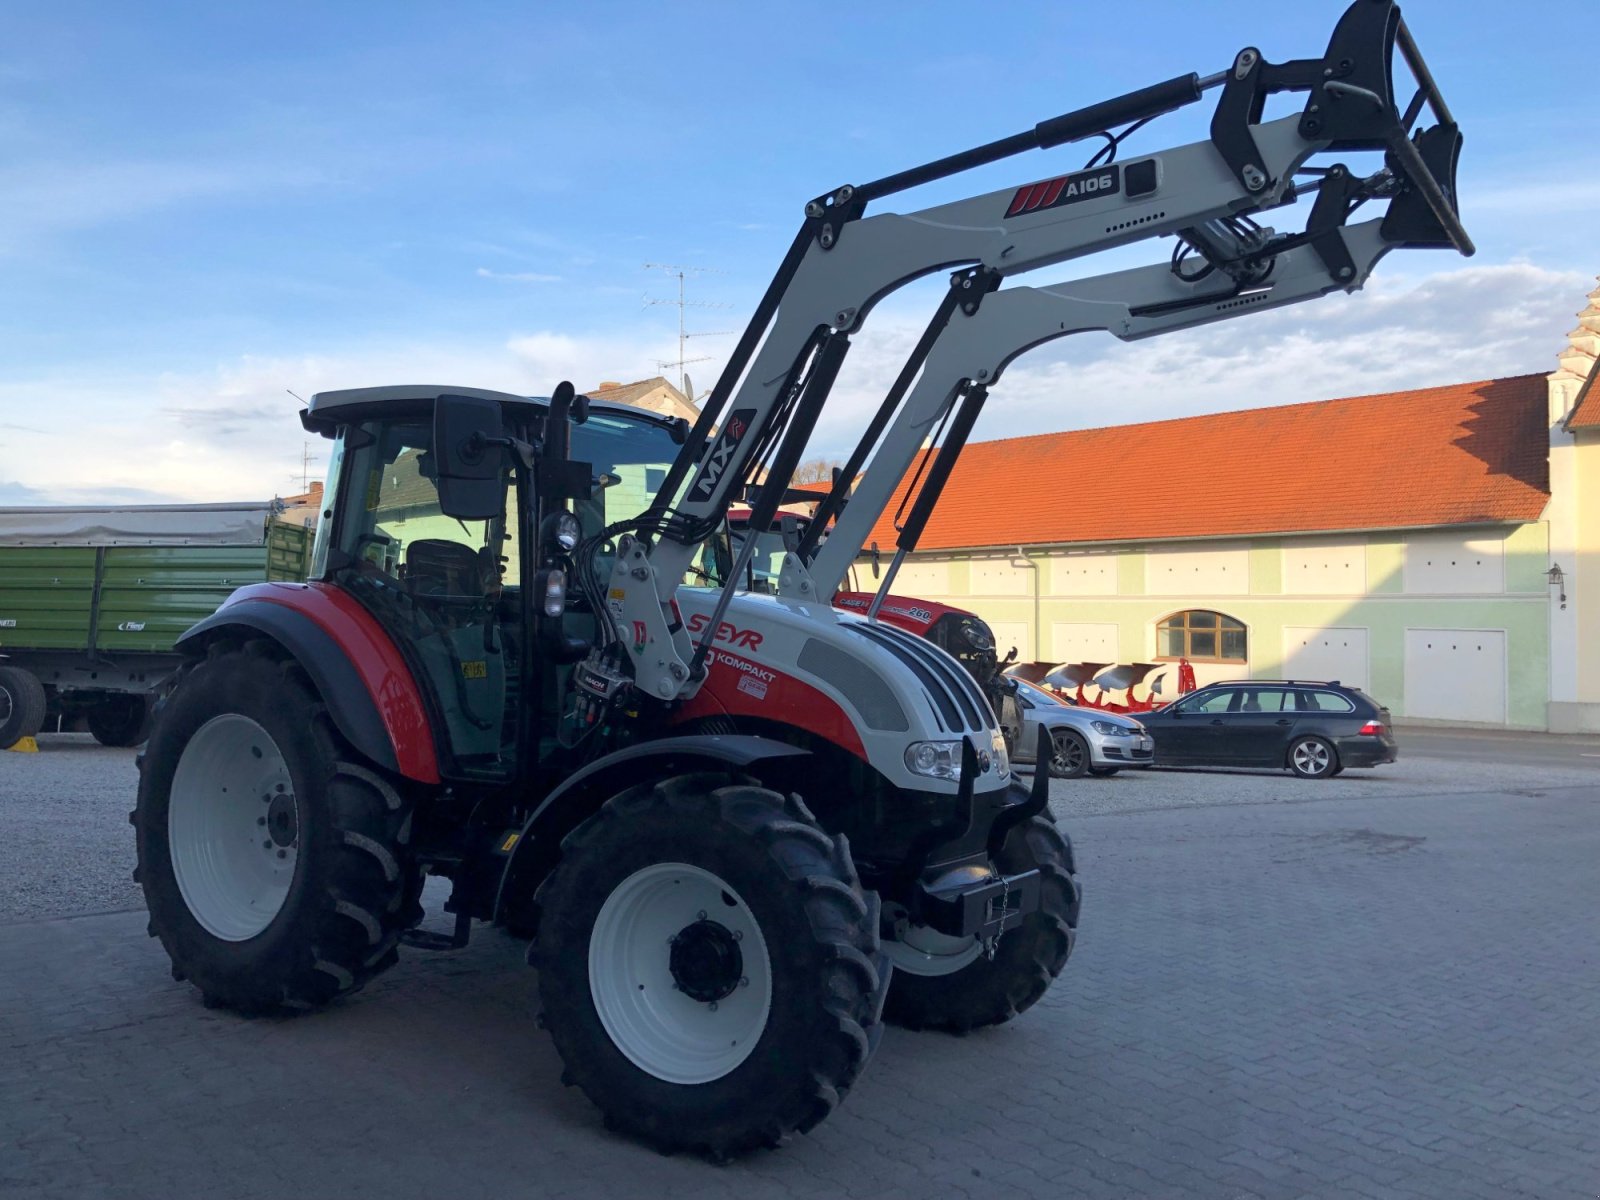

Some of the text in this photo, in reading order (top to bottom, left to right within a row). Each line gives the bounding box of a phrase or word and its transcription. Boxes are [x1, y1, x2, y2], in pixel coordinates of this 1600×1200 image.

[1066, 175, 1112, 197] A106
[698, 436, 736, 495] MX
[908, 607, 931, 619] 260
[687, 613, 763, 652] SEYR
[717, 652, 776, 682] KOMPAKT
